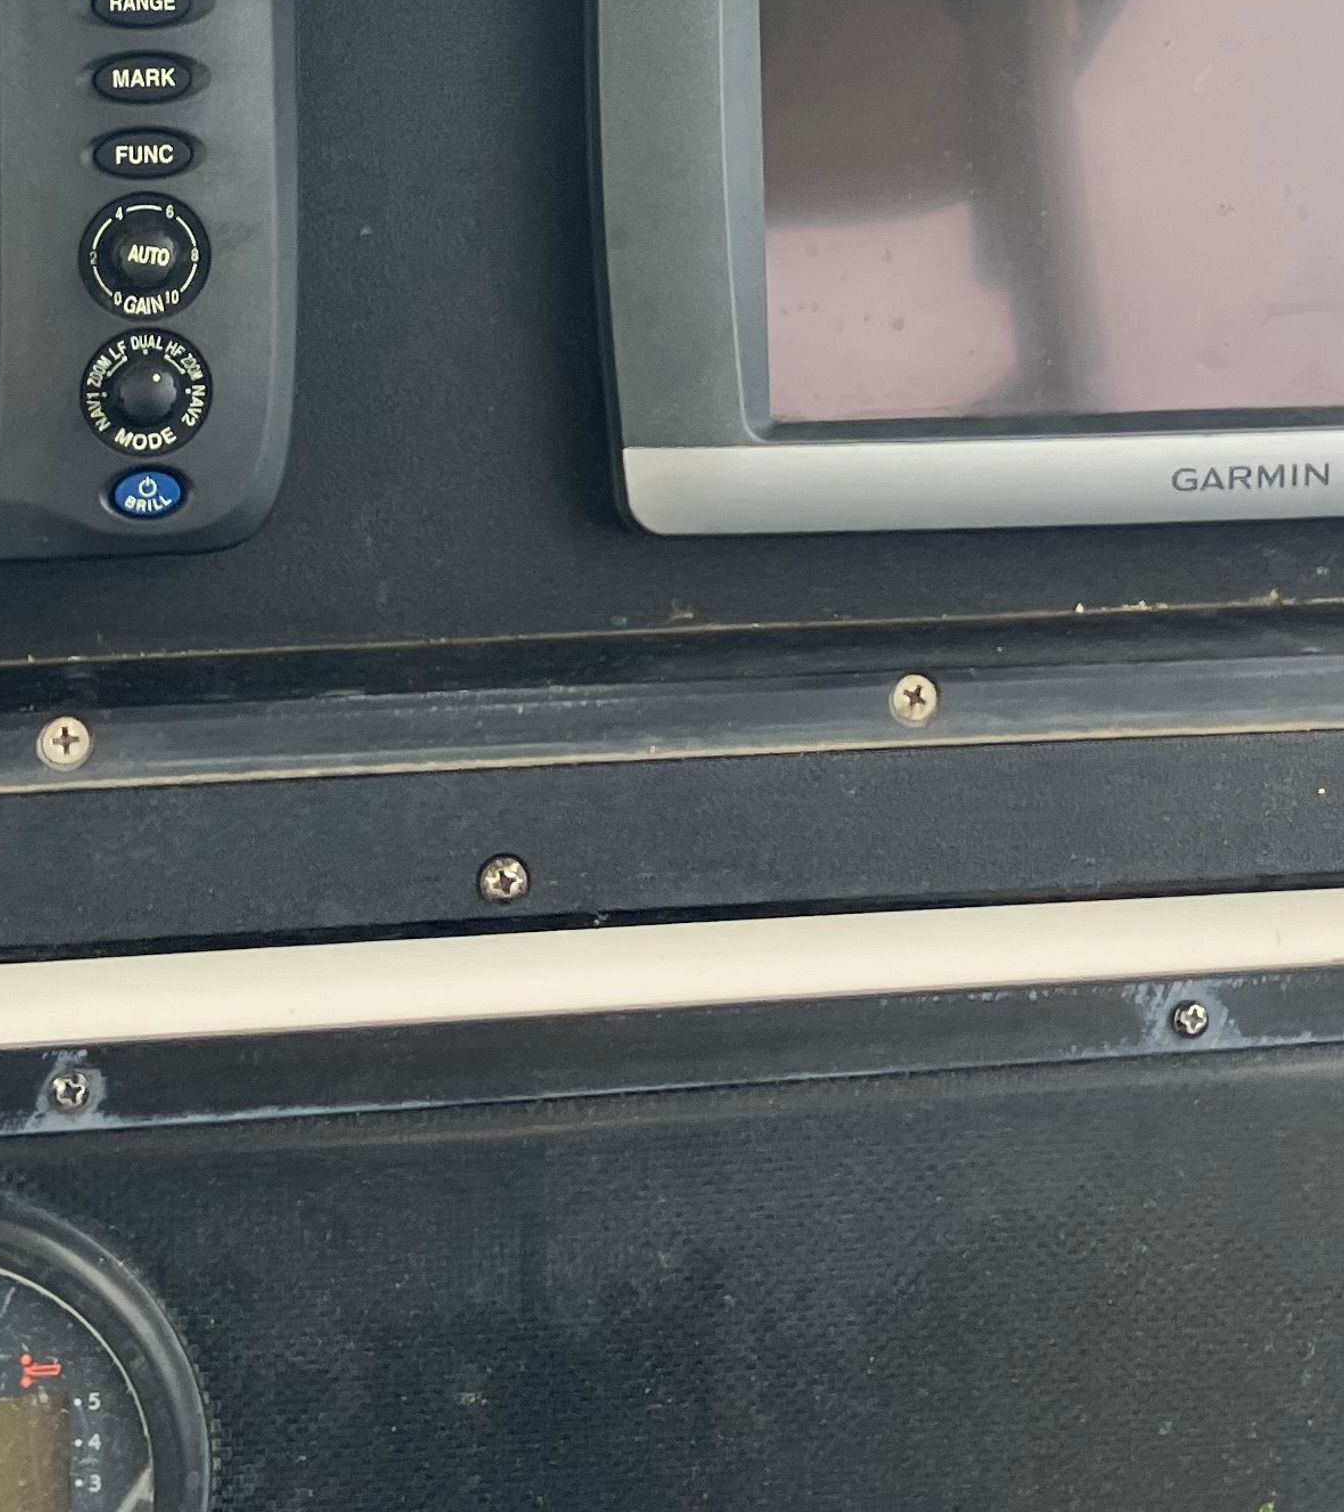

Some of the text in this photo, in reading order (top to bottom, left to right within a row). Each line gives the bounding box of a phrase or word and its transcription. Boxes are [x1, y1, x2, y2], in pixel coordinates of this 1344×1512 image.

[112, 68, 176, 88] MARK
[115, 144, 174, 164] FUNC
[127, 244, 171, 267] AUTO
[123, 295, 165, 315] GAIN
[108, 340, 128, 359] LF
[130, 335, 164, 351] DUAL
[164, 340, 186, 357] HF
[86, 392, 111, 433] NAV1
[181, 385, 206, 428] NAV2
[114, 426, 177, 451] MODE
[1171, 462, 1330, 491] GARMIN
[124, 495, 172, 513] BRILL
[87, 1392, 102, 1411] 5
[87, 1433, 102, 1451] 4
[88, 1474, 102, 1493] 3
